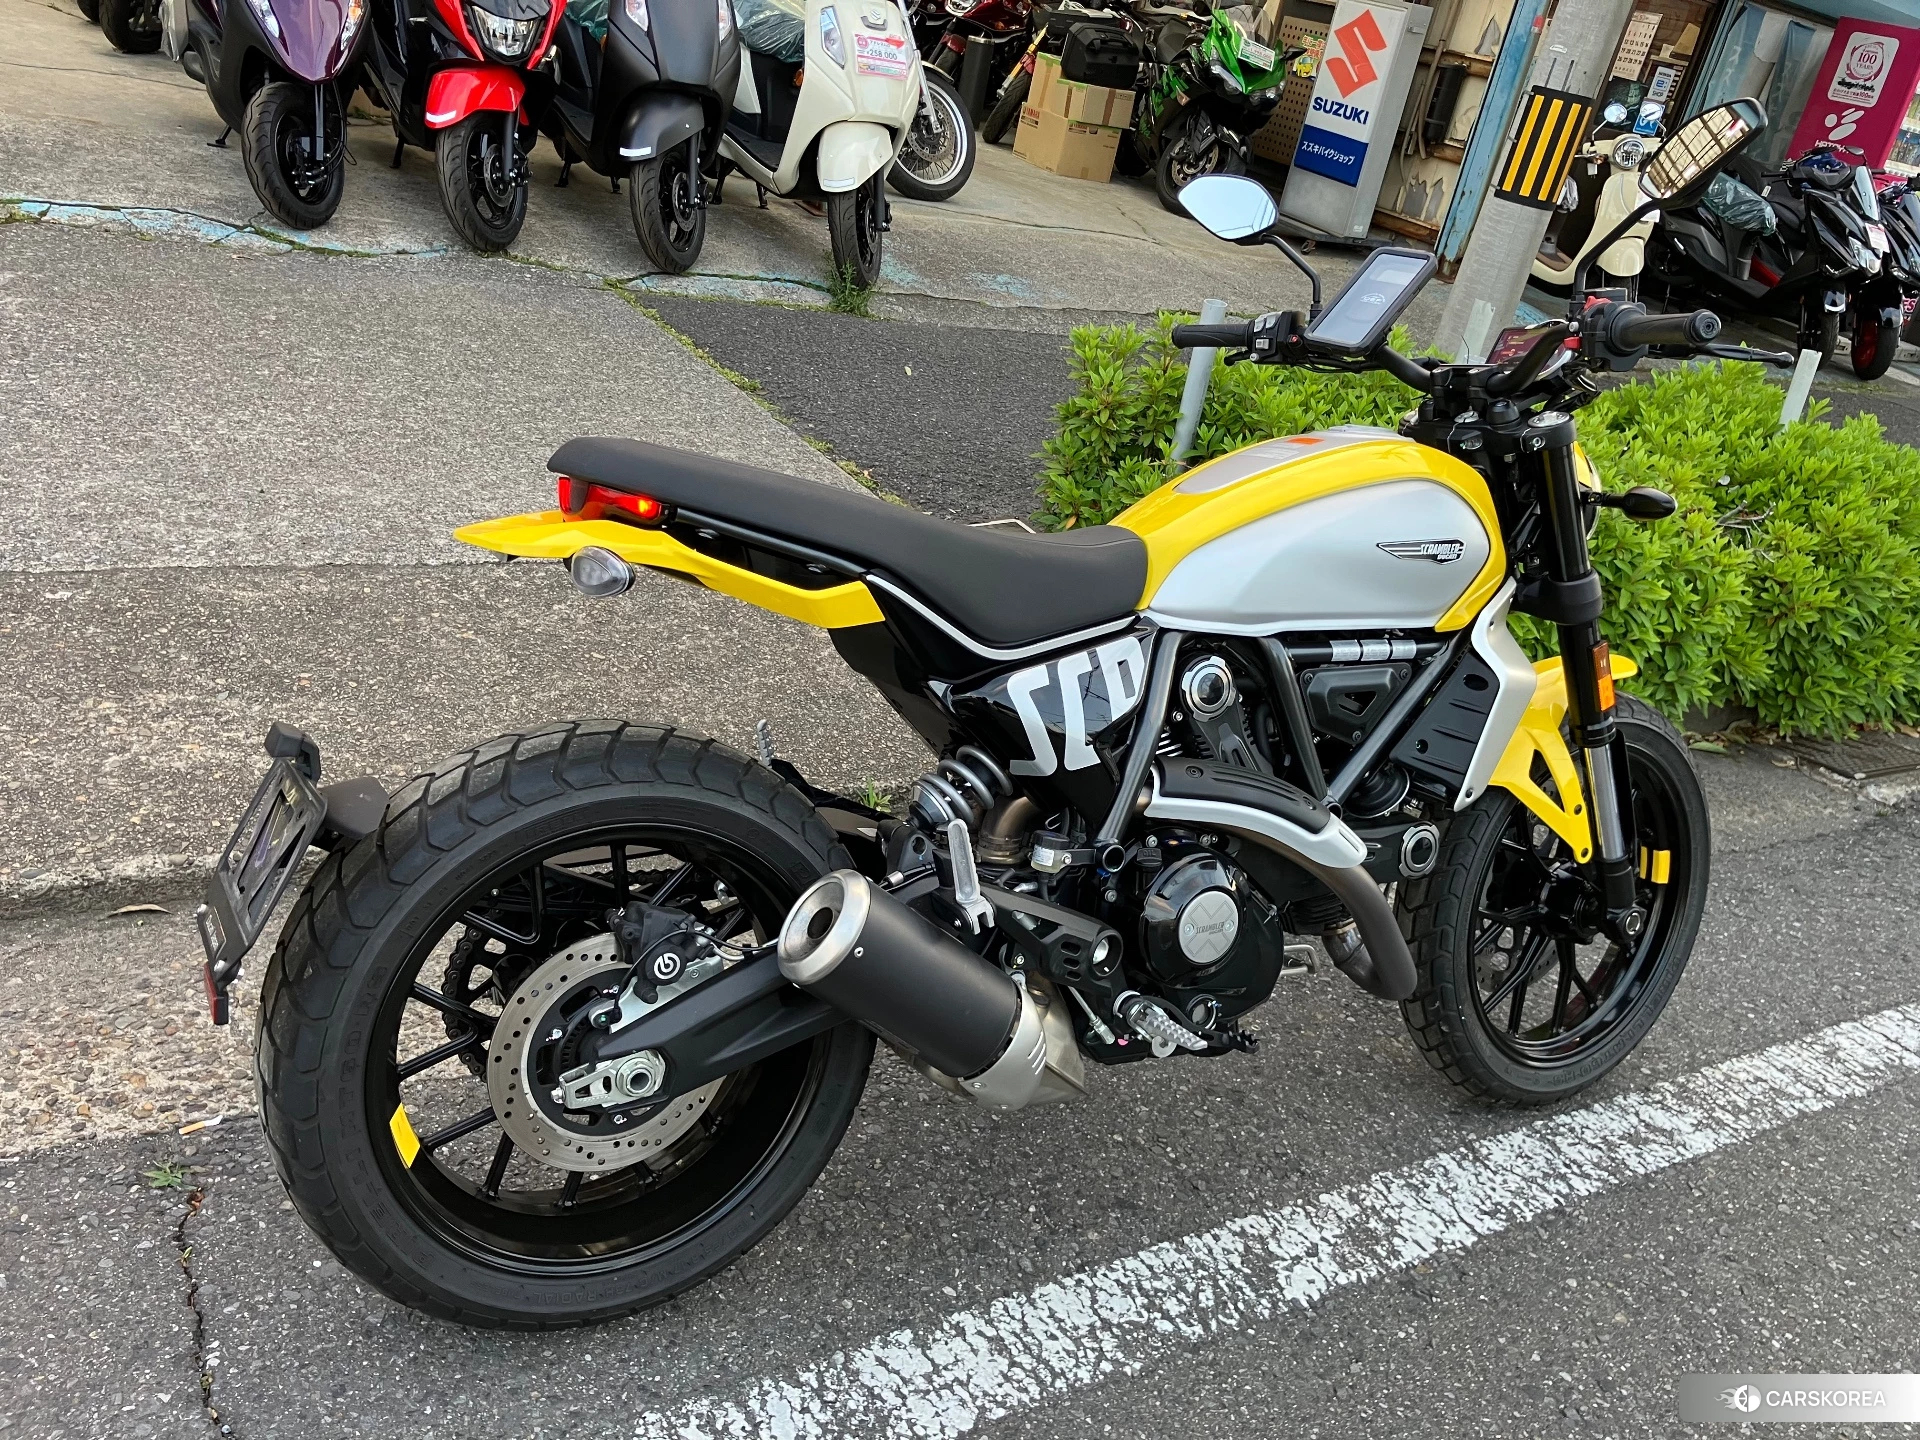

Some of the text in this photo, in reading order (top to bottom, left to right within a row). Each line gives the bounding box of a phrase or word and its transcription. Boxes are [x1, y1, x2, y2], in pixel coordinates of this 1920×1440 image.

[1858, 53, 1877, 64] 100
[1312, 96, 1369, 125] SUZUKI
[1301, 141, 1356, 166] スズキバイクショップ
[1420, 544, 1460, 554] SCRAMBLER
[1196, 921, 1224, 934] SCRAMBLER
